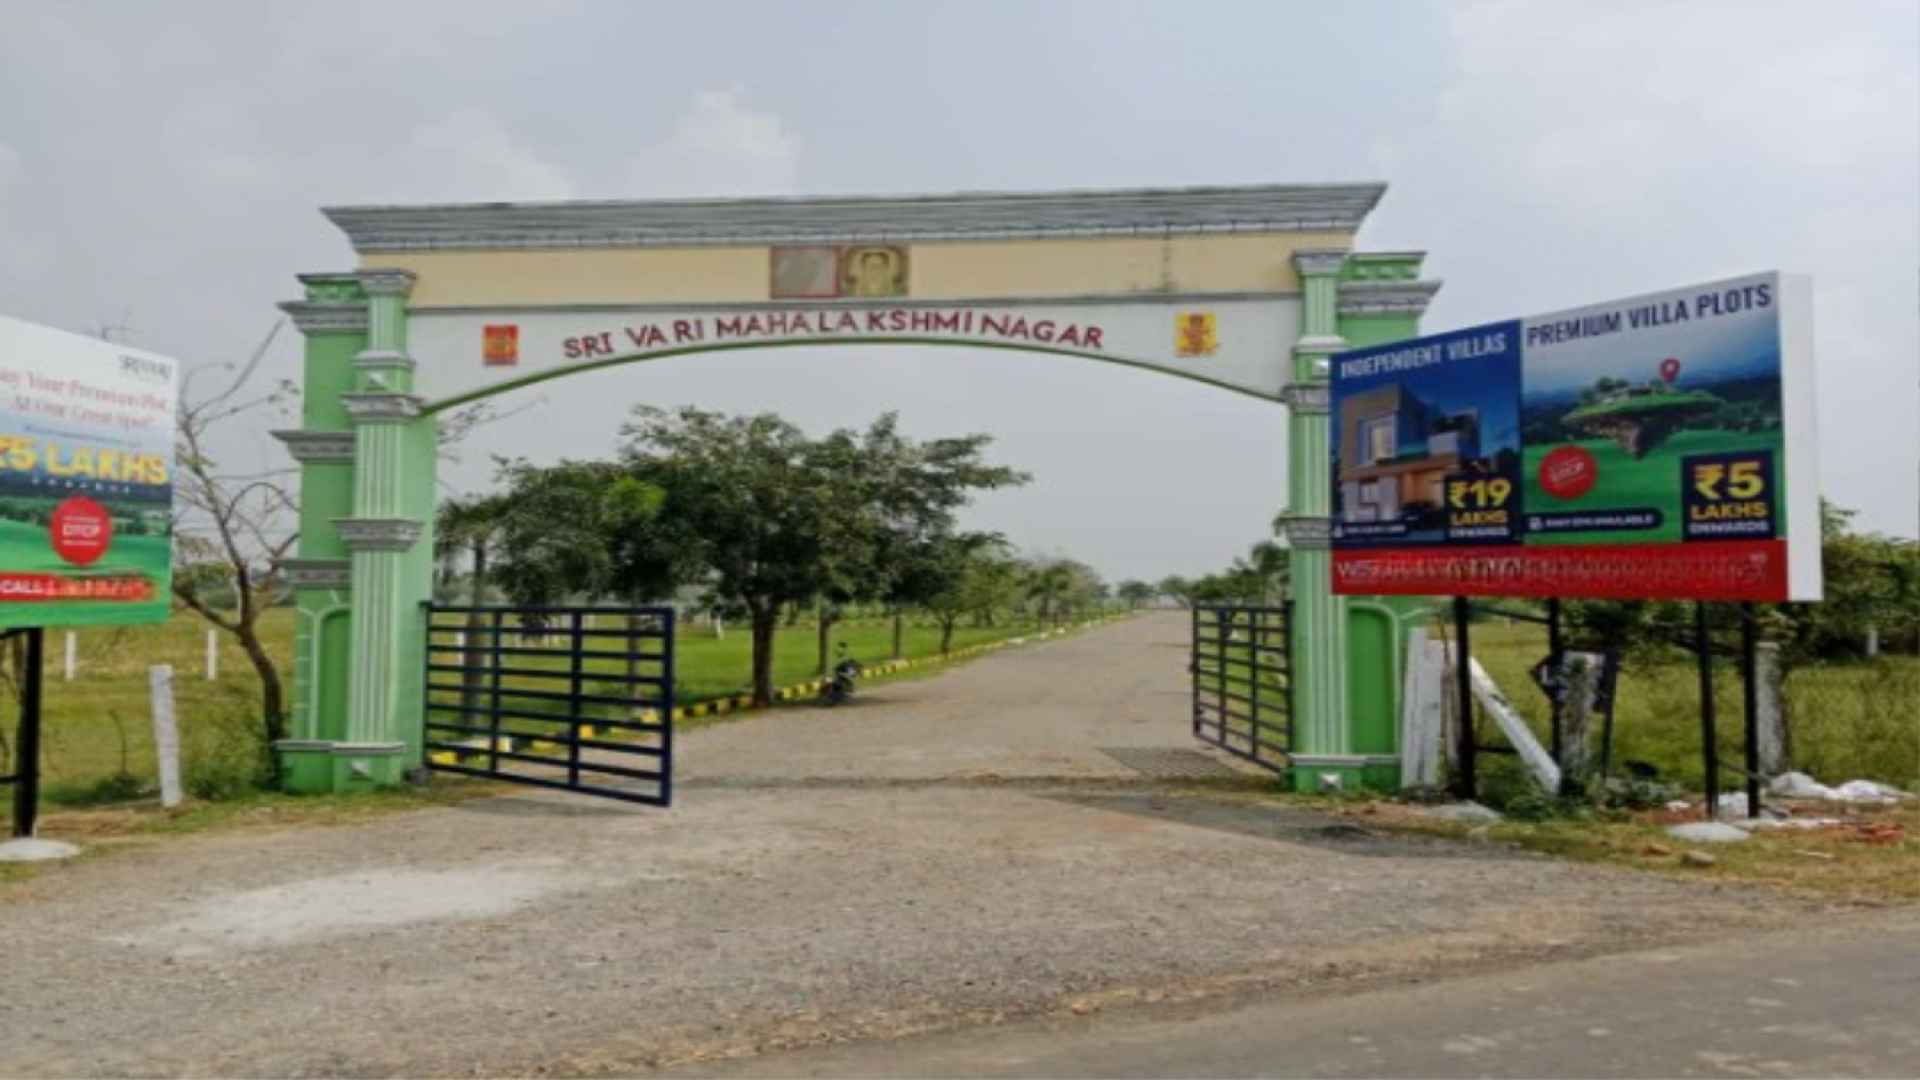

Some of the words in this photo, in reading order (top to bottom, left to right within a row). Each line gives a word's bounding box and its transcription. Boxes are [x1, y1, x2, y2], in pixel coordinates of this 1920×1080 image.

[1527, 311, 1622, 347] PREMIUM
[1628, 300, 1690, 328] VILLA
[1696, 284, 1772, 317] PLOTS
[563, 332, 614, 358] SRI
[981, 314, 1105, 348] NAGAR
[1341, 344, 1442, 378] INDEPENDENT
[1447, 332, 1507, 360] VILLAS
[46, 441, 168, 484] LAKHS
[1694, 461, 1765, 499] ₹5
[1448, 478, 1511, 508] ₹19
[1690, 501, 1768, 520] LAKHS
[1452, 509, 1508, 526] LAKHS
